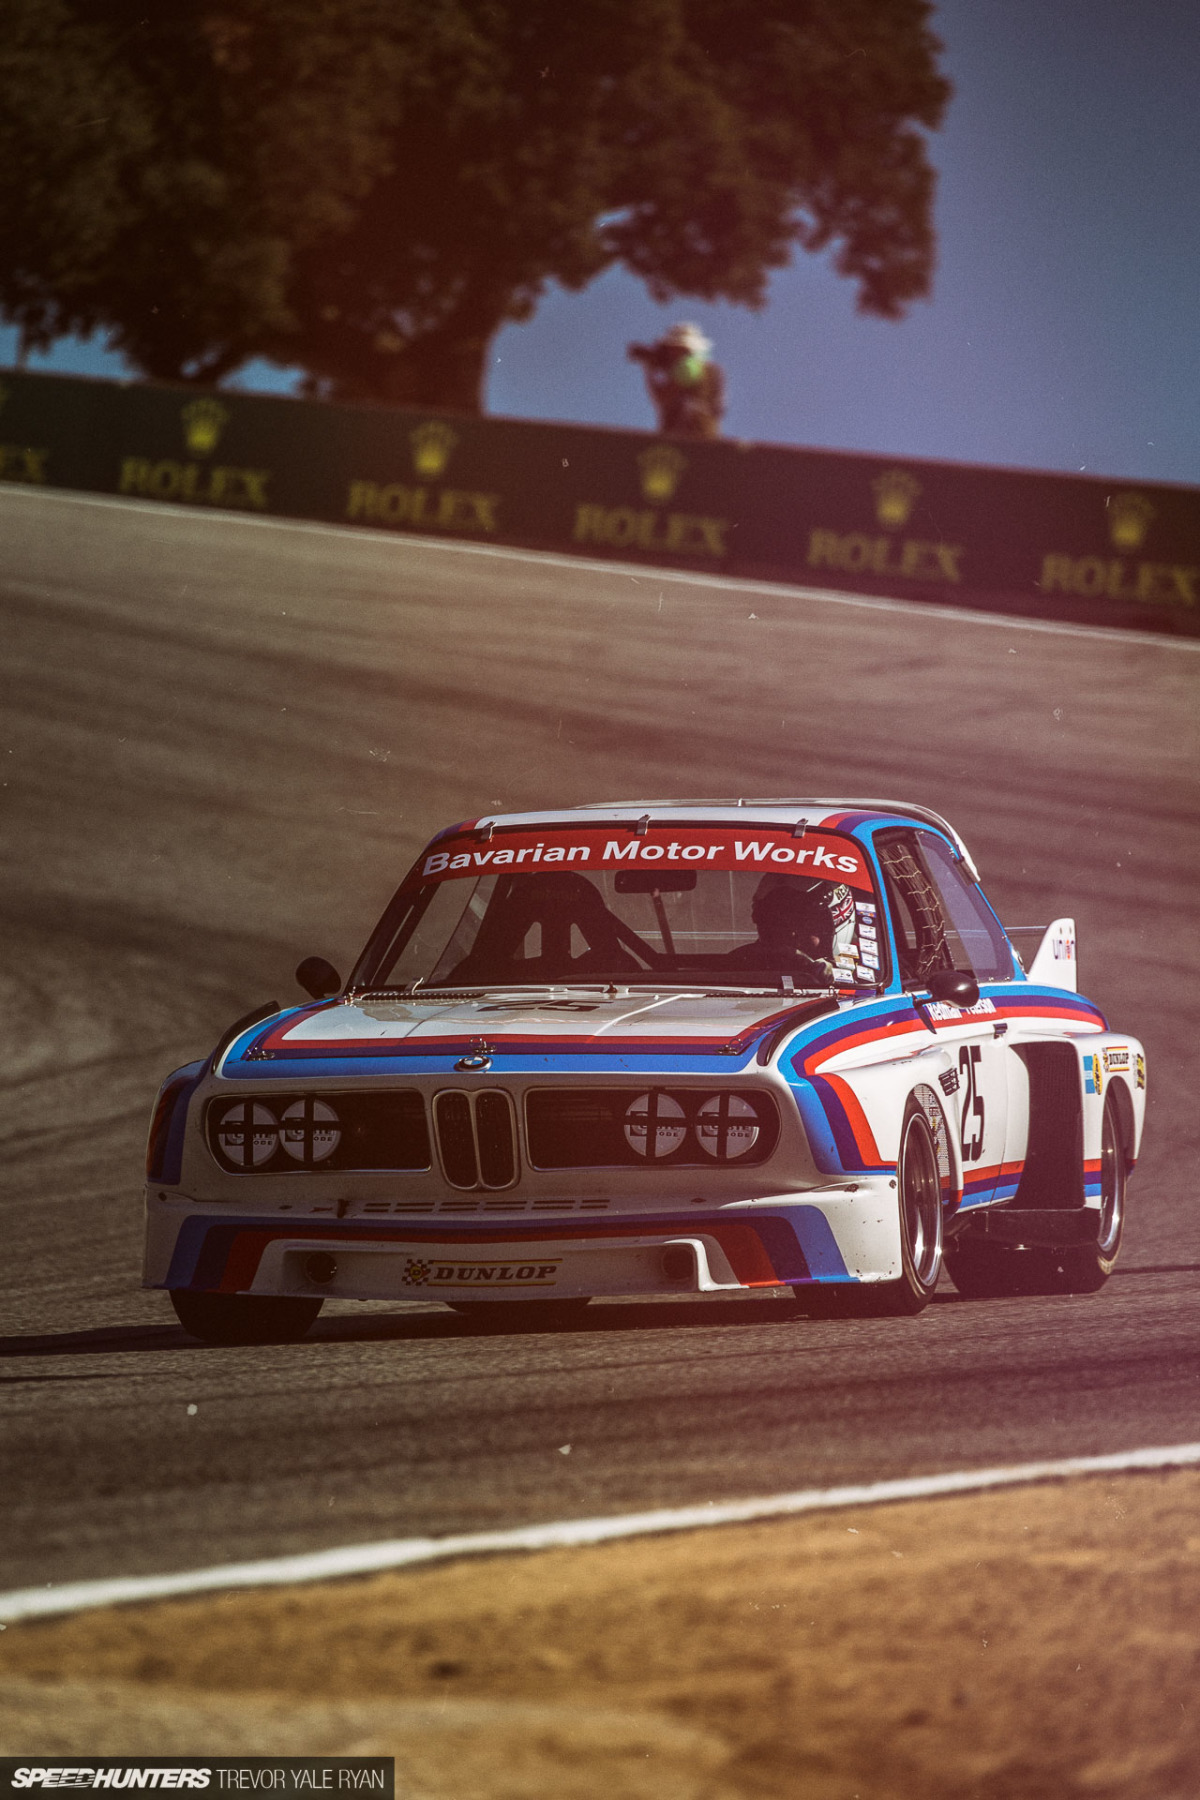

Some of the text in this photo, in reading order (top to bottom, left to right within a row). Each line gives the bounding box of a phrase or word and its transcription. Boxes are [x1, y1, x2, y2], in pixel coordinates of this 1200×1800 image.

[118, 457, 272, 507] ROLEX
[346, 480, 502, 533] ROLEX
[572, 503, 731, 557] ROLEX
[807, 528, 962, 583] ROLEX
[1040, 553, 1200, 606] ROLEX
[422, 839, 859, 877] Bavarian Motor Works
[1108, 1053, 1129, 1065] DUNLOP
[958, 1045, 985, 1162] 25
[433, 1265, 557, 1281] DUNLOP
